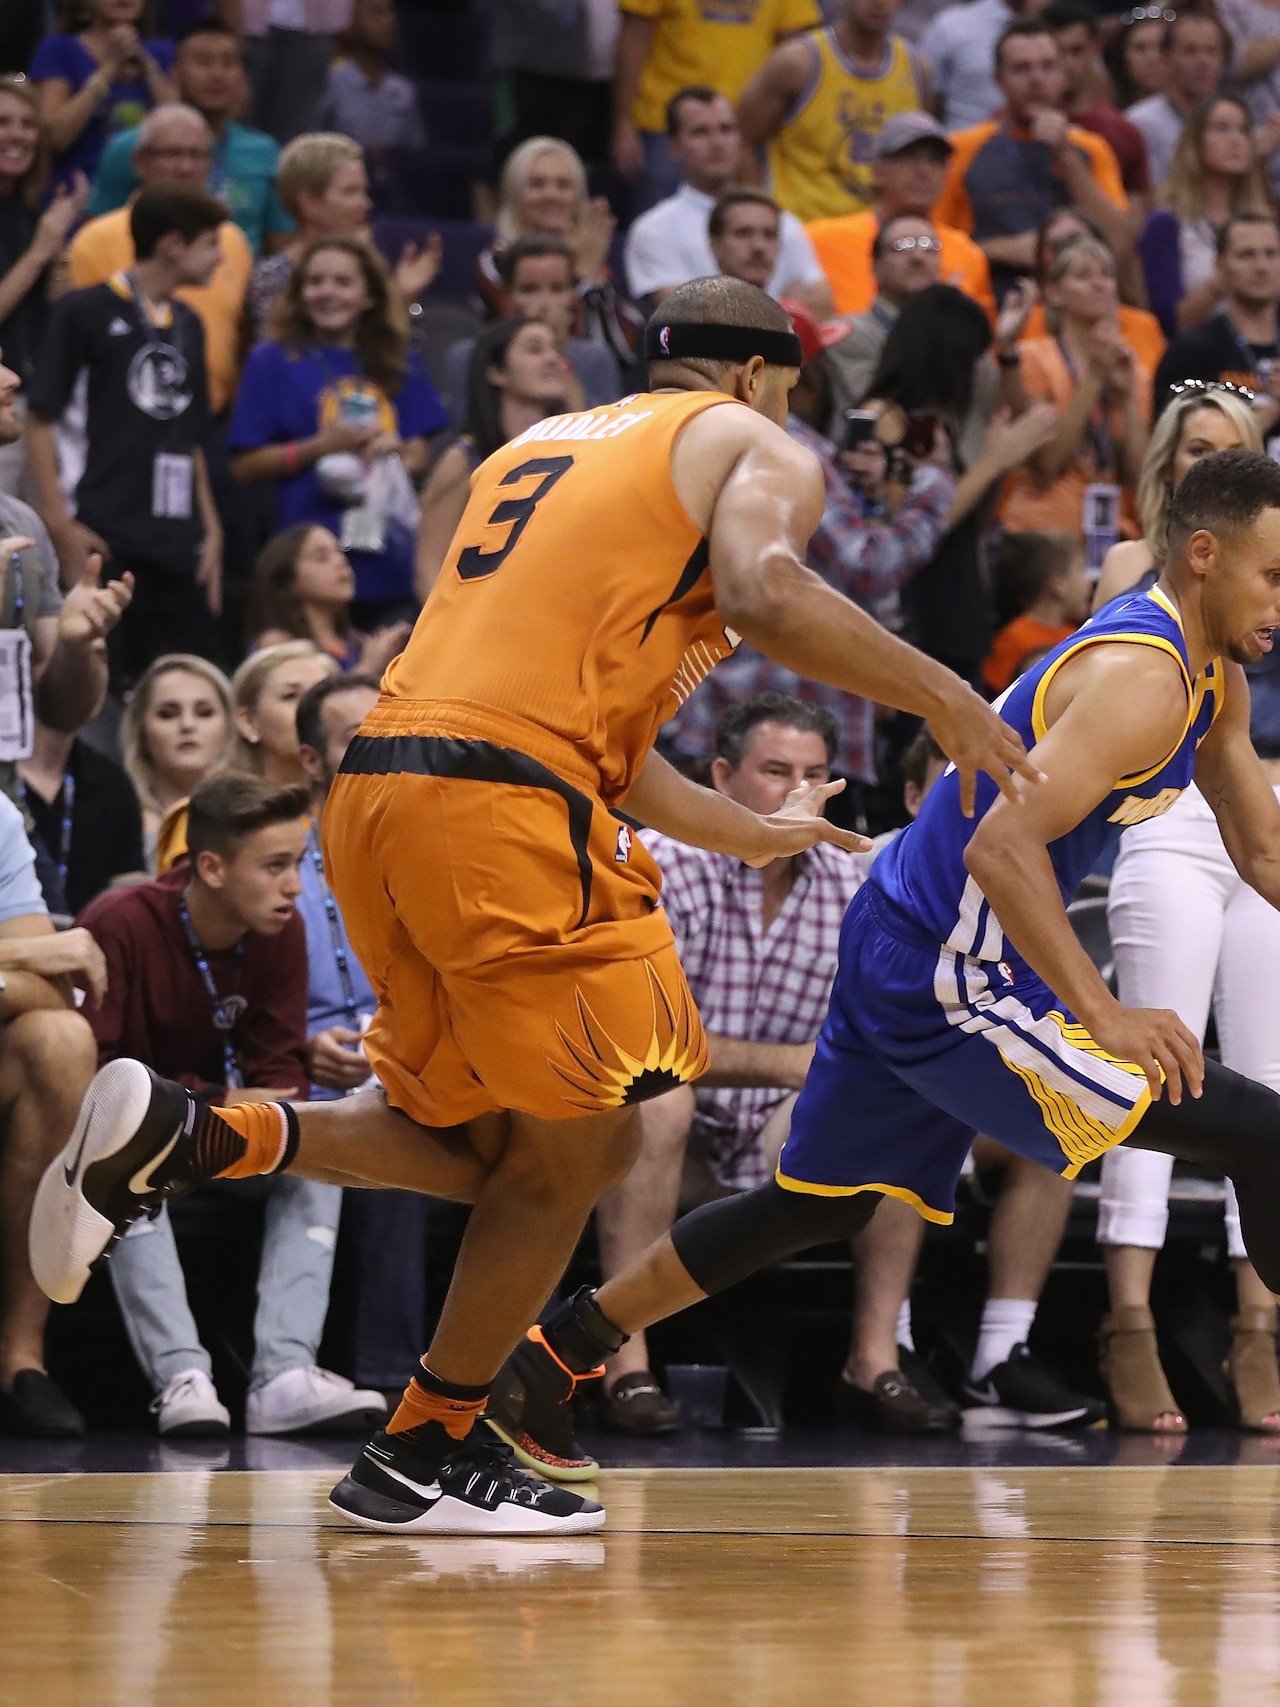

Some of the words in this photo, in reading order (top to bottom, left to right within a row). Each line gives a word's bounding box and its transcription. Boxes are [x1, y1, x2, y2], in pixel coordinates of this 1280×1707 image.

[511, 411, 653, 449] DUDLEY
[457, 455, 575, 580] 3
[1106, 787, 1185, 825] WAR
